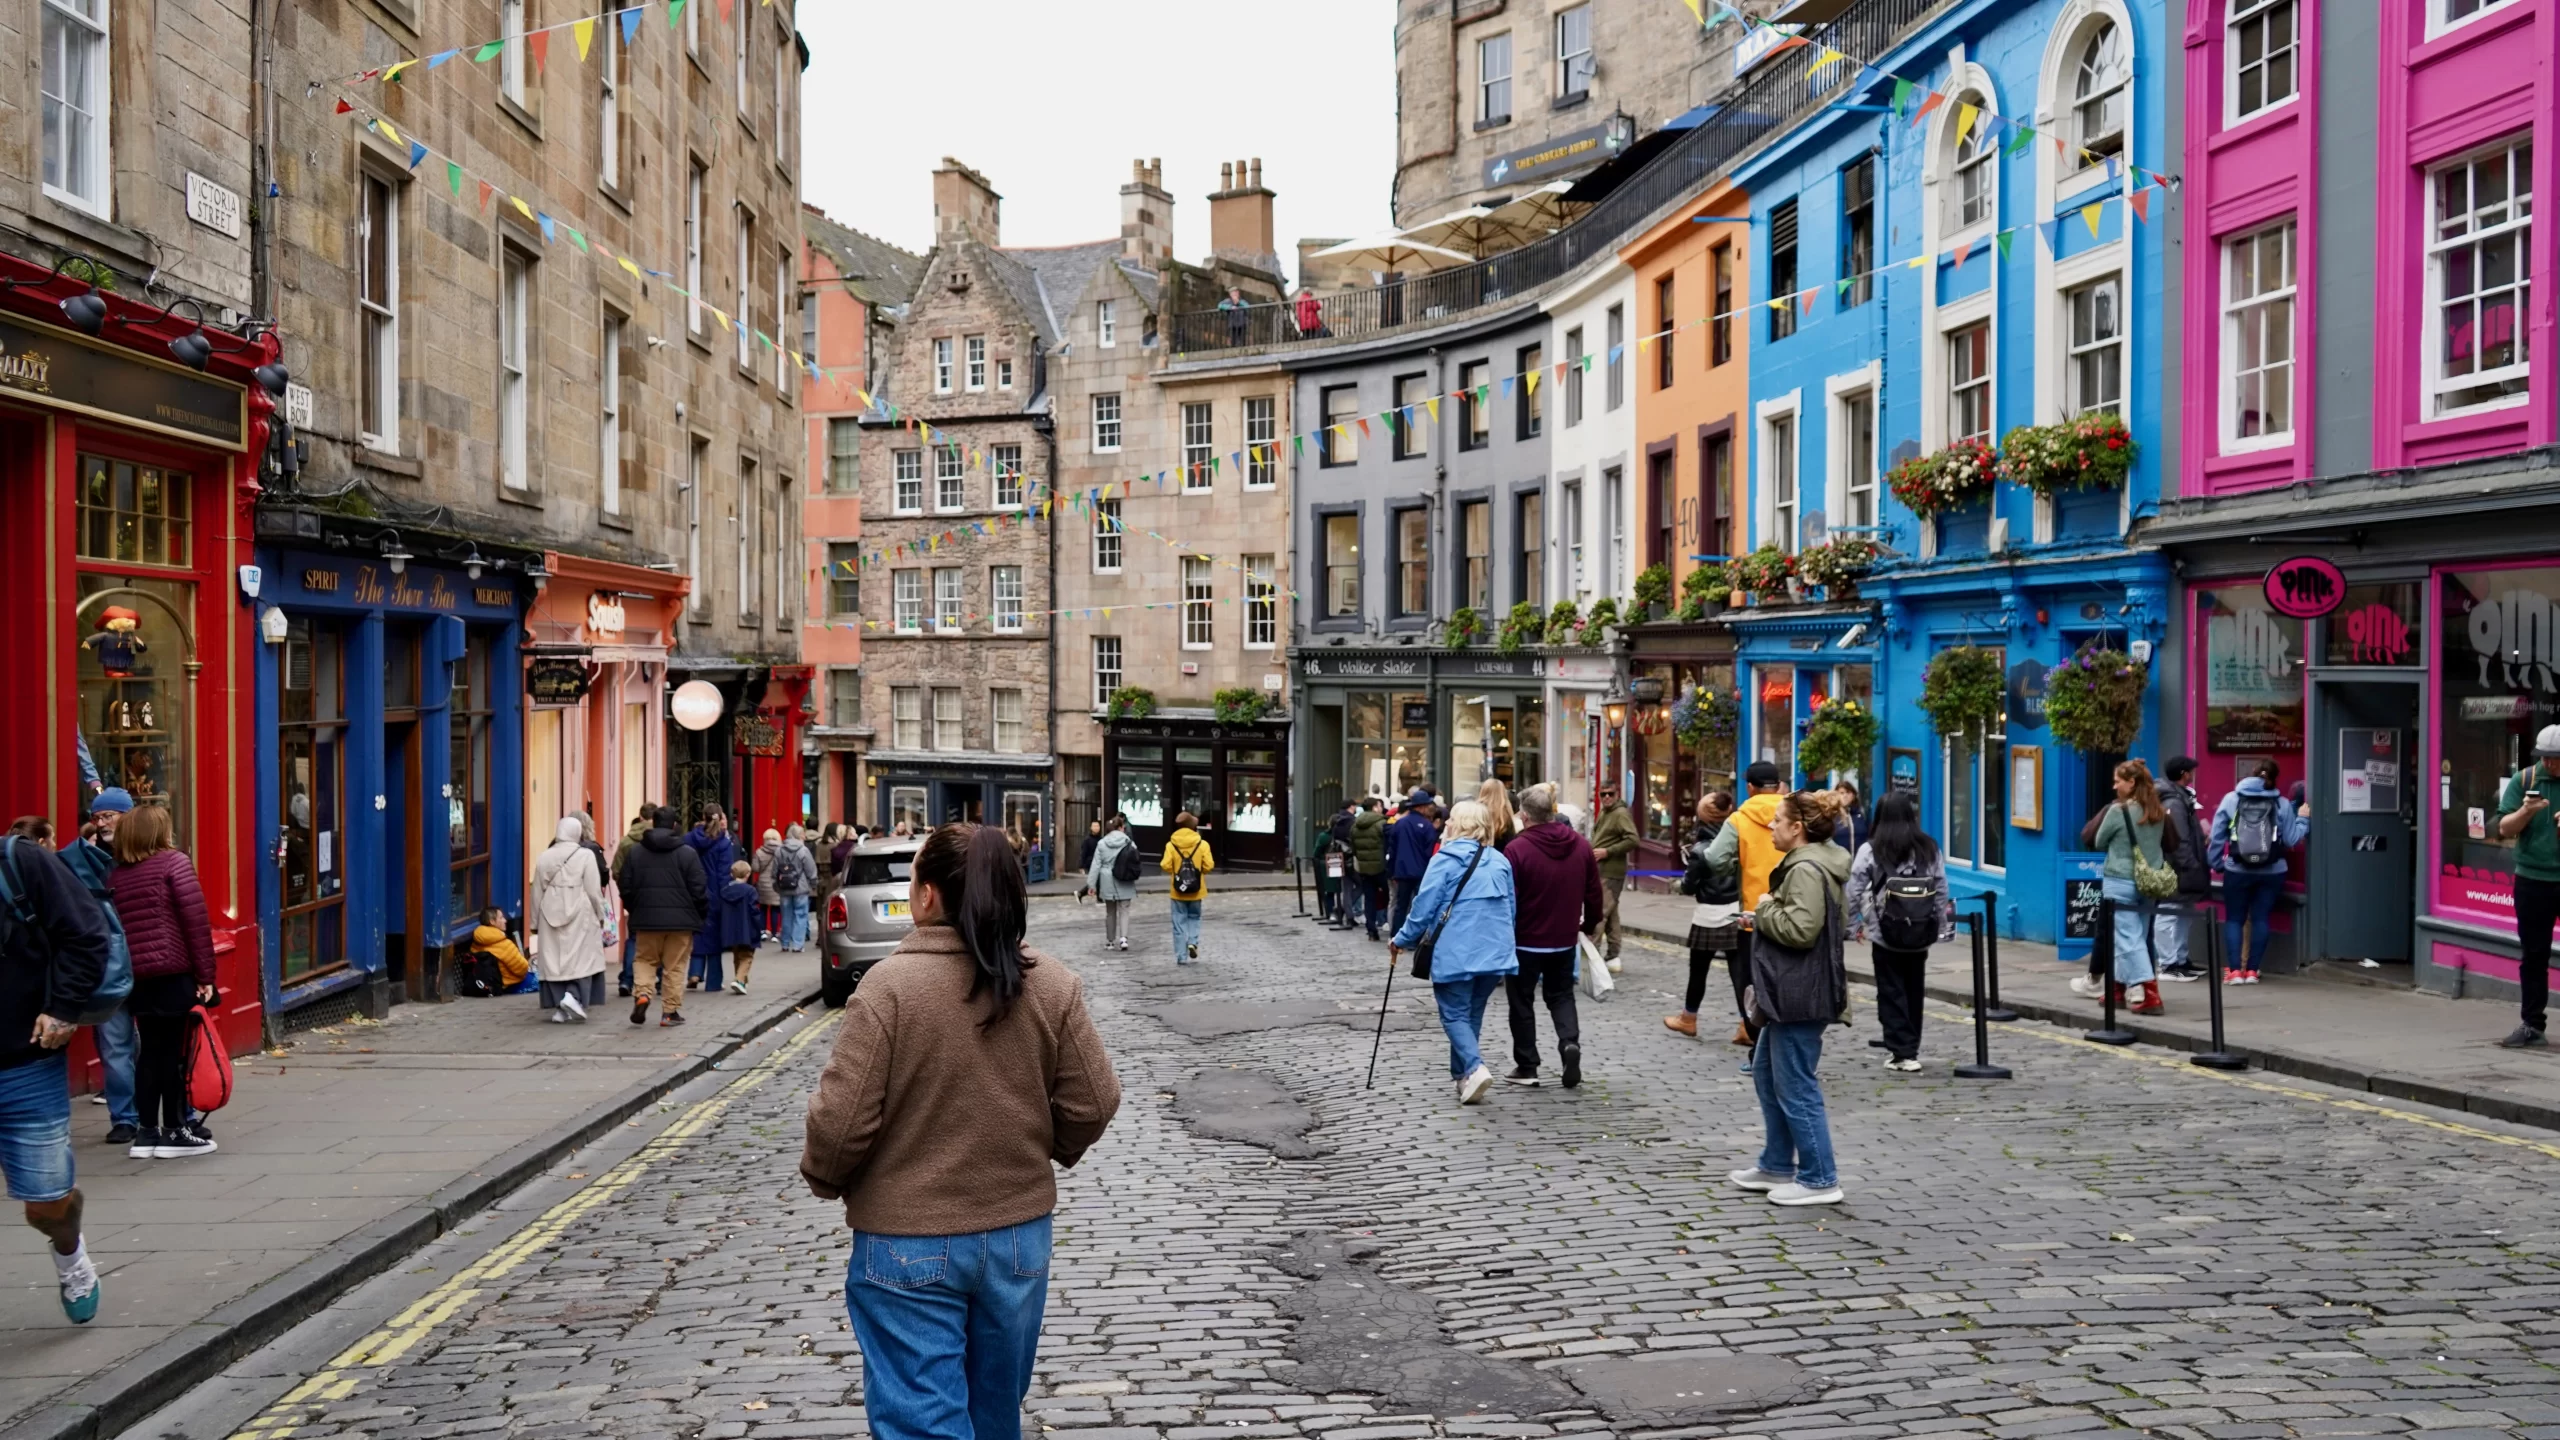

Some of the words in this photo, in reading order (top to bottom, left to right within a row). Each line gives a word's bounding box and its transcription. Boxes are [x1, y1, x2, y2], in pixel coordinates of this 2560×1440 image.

[190, 176, 236, 214] VICTORIA
[198, 201, 232, 231] STREET
[0, 355, 48, 383] ALAXY
[288, 386, 310, 407] WEST
[290, 407, 309, 422] BOW
[1678, 496, 1697, 547] 40
[305, 569, 339, 591] SPIRIT
[355, 565, 385, 604] The
[430, 574, 455, 609] Bar
[475, 587, 513, 606] MERCHANT
[588, 594, 625, 637] Squish
[1338, 659, 1377, 674] Walker
[1382, 659, 1416, 675] Slater
[2539, 701, 2555, 714] hog
[2466, 889, 2515, 907] www.oinkh
